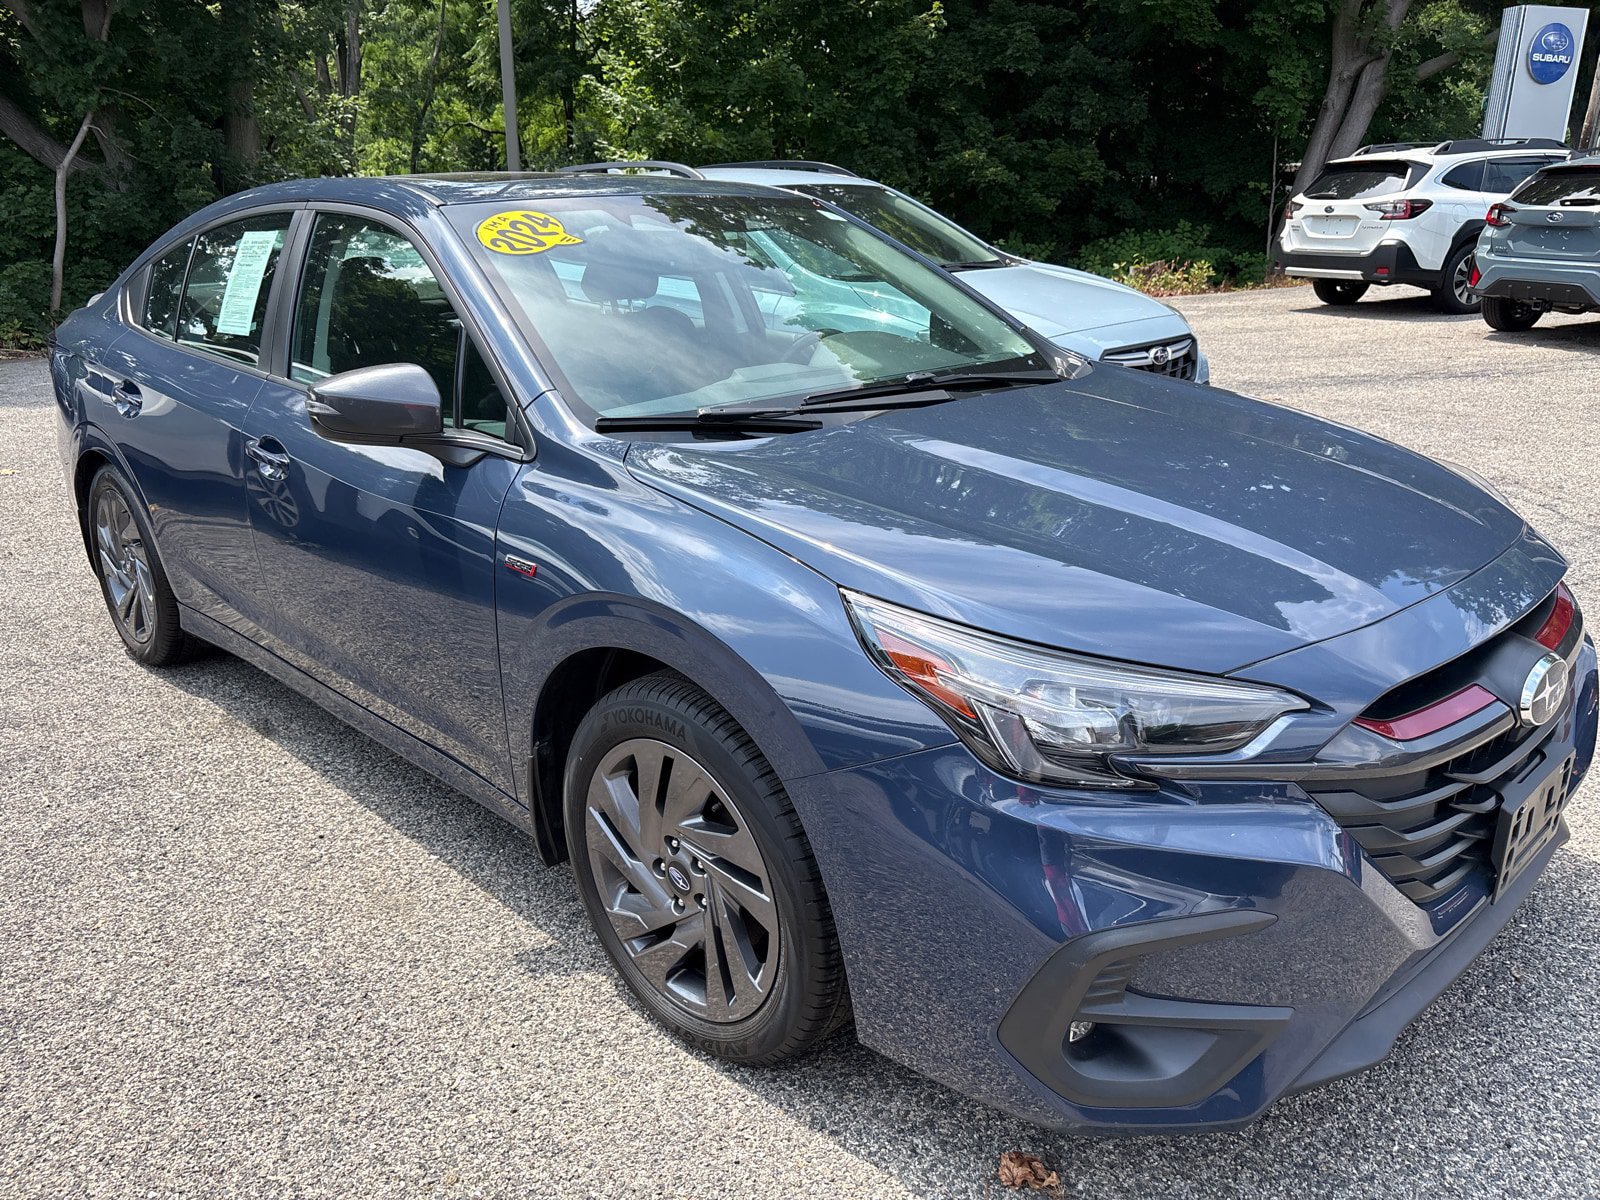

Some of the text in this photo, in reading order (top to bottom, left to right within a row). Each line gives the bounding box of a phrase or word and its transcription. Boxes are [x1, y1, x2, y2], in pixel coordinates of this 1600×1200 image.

[1532, 53, 1570, 64] SUBARU
[490, 214, 559, 251] 2024
[611, 708, 686, 742] YOKOHAMA
